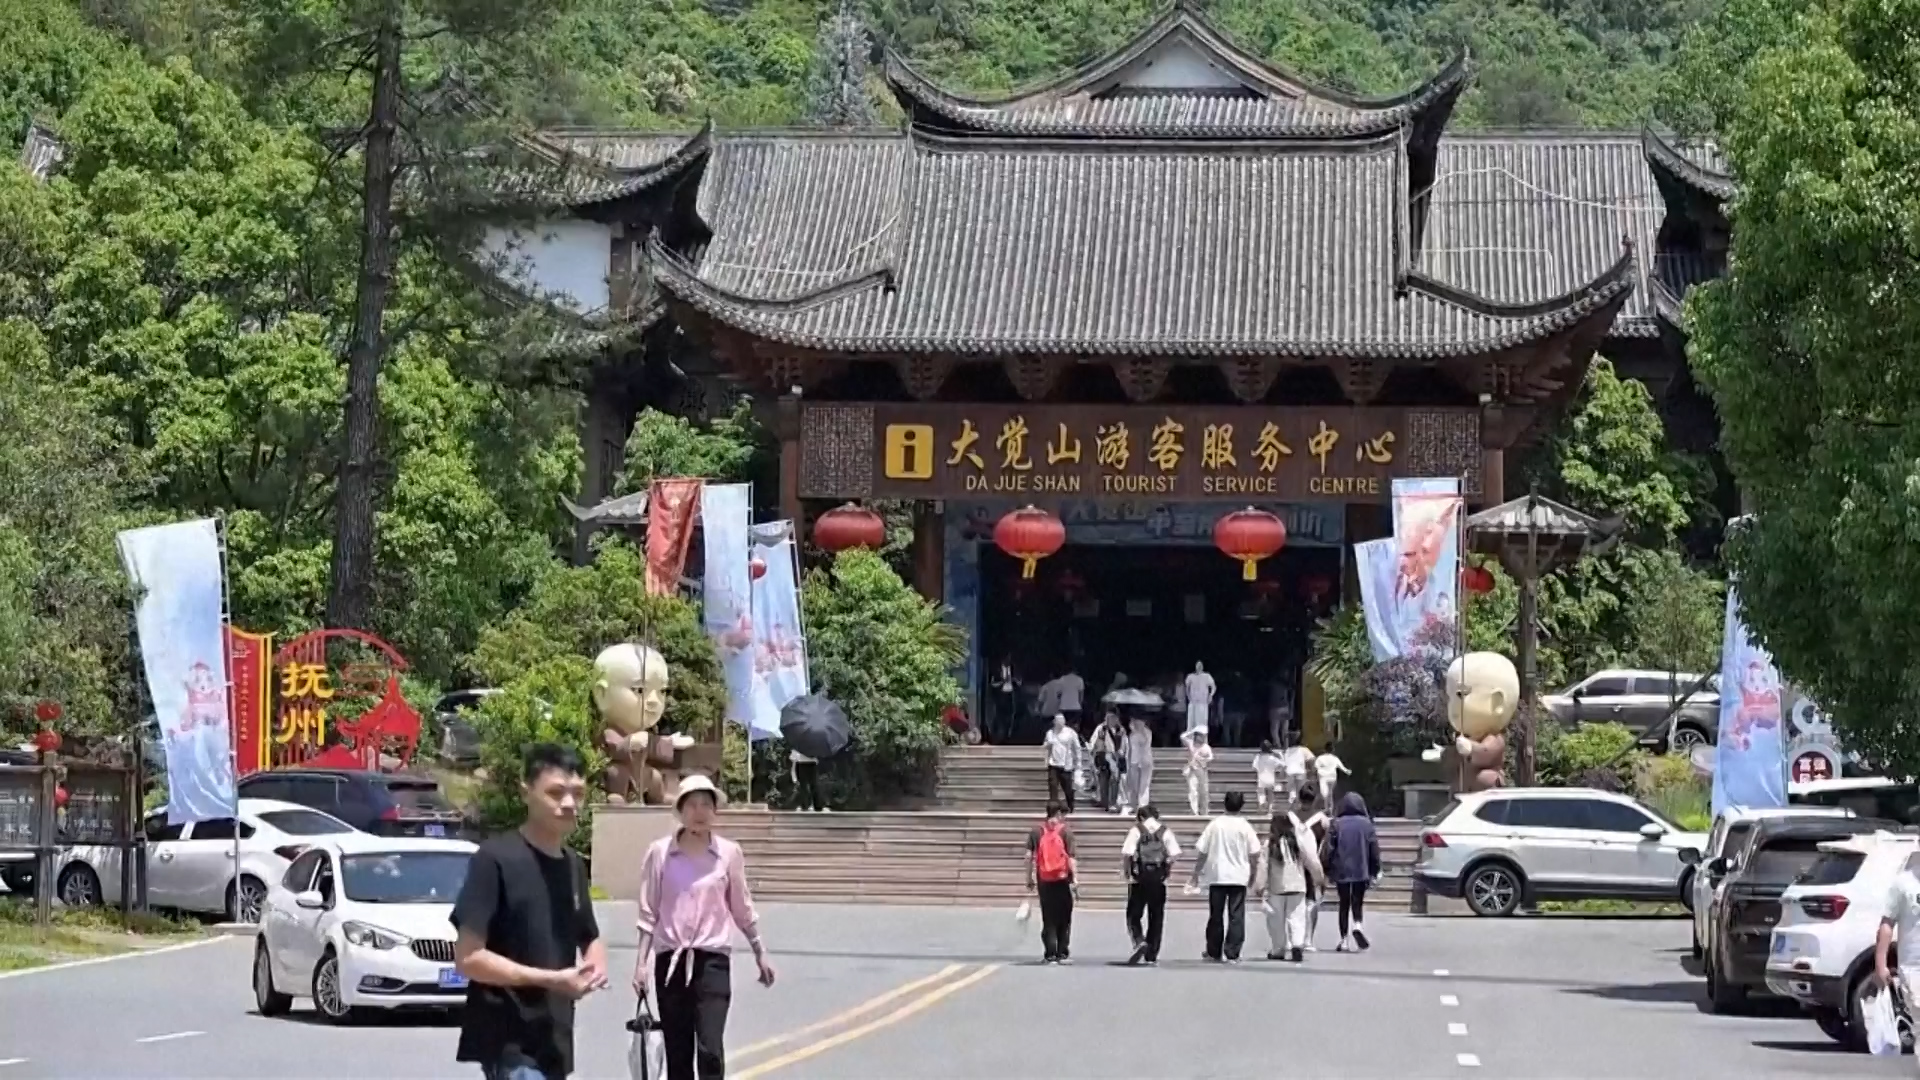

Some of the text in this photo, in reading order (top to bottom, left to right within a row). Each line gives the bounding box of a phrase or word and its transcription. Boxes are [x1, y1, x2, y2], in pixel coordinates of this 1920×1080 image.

[946, 415, 1396, 475] 大觉山游客服务中心
[966, 475, 1380, 495] DA JUE SHAN TOURIST SERVICE CENTRE
[276, 661, 335, 746] 抚州
